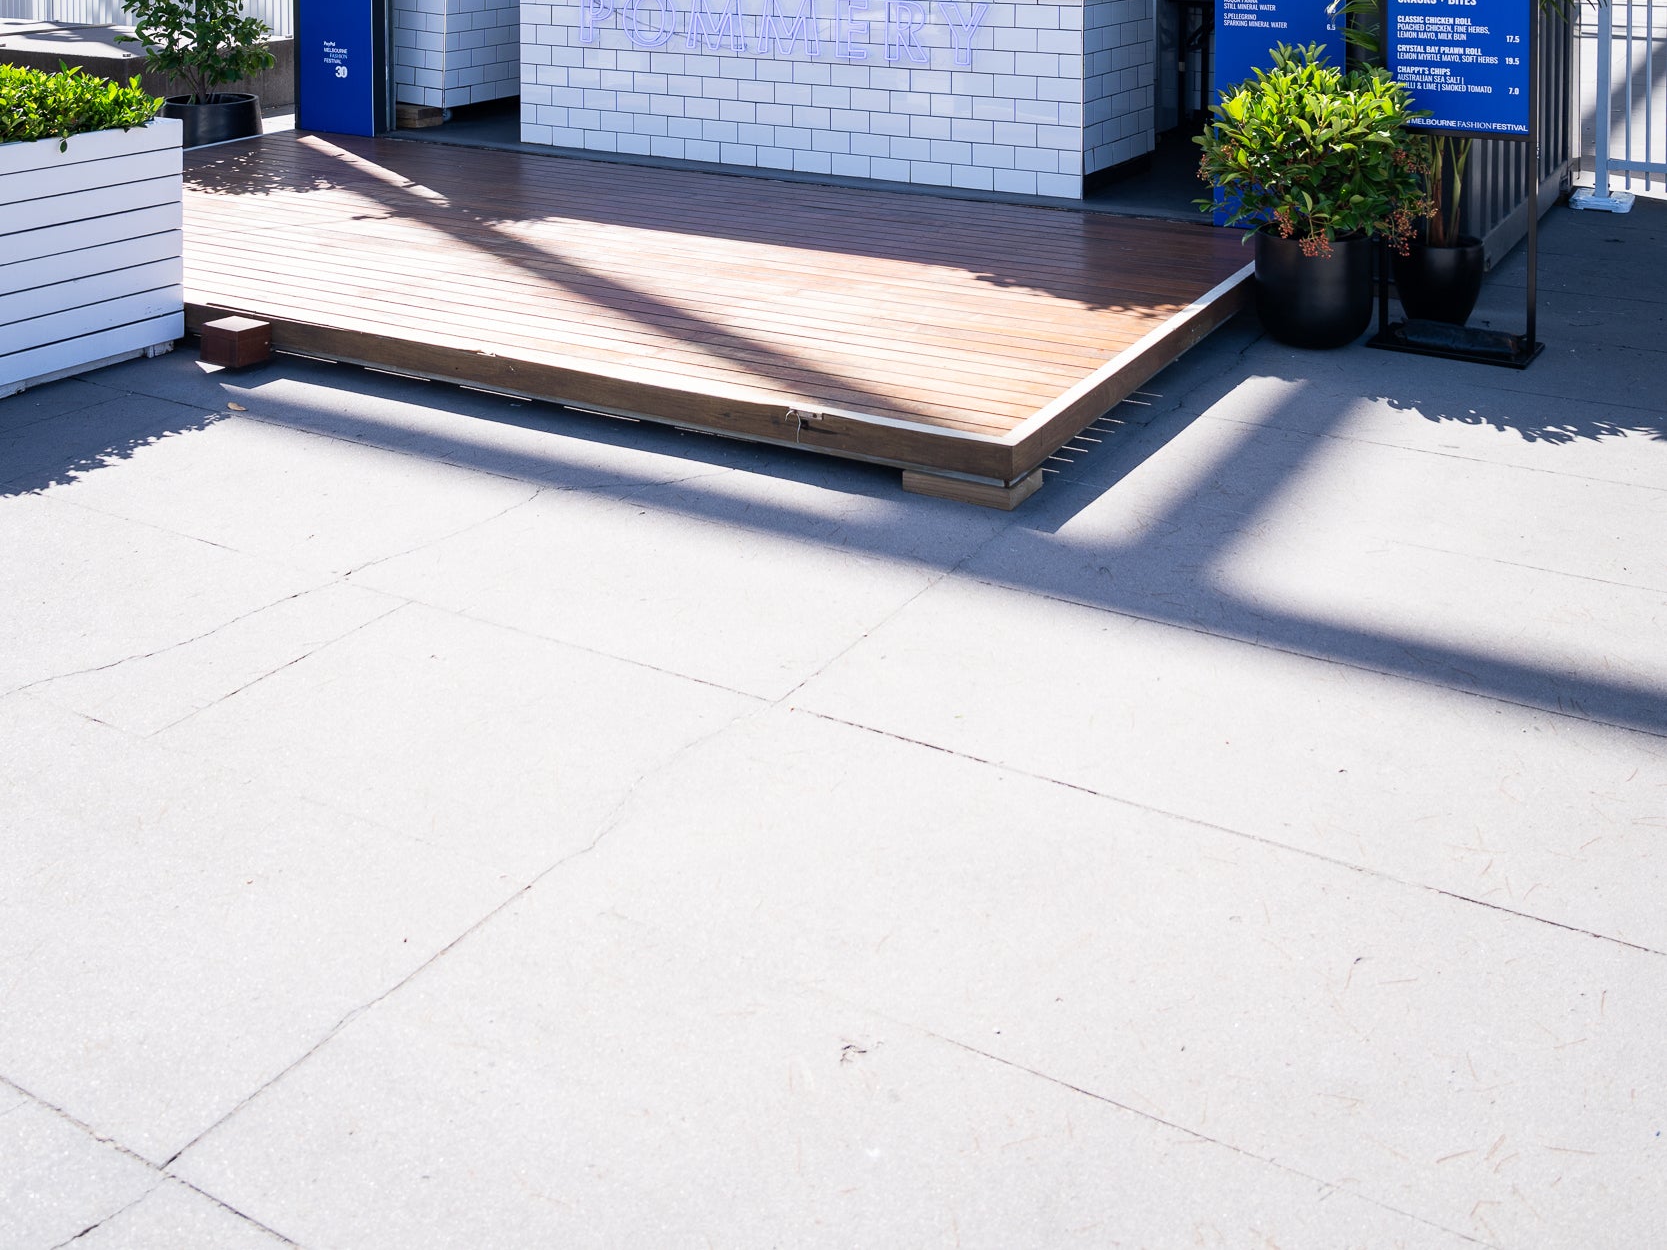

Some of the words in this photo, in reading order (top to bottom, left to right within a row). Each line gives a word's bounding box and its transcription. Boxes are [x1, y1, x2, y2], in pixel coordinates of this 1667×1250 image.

[1398, 15, 1424, 23] CLASSIC
[1425, 16, 1454, 24] CHICKEN
[1418, 32, 1436, 40] MAYO,
[1397, 44, 1424, 52] CRYSTAL
[1440, 46, 1464, 54] PRAWN
[1418, 54, 1440, 62] MYRTLE
[335, 66, 348, 78] 30
[1397, 74, 1433, 82] AUSTRALIAN
[1442, 84, 1466, 92] SMOKED
[1468, 86, 1492, 94] TOMATO
[1412, 118, 1456, 127] MELBOURNE
[1457, 120, 1492, 129] FASHION
[1492, 123, 1528, 132] FESTIVAL
